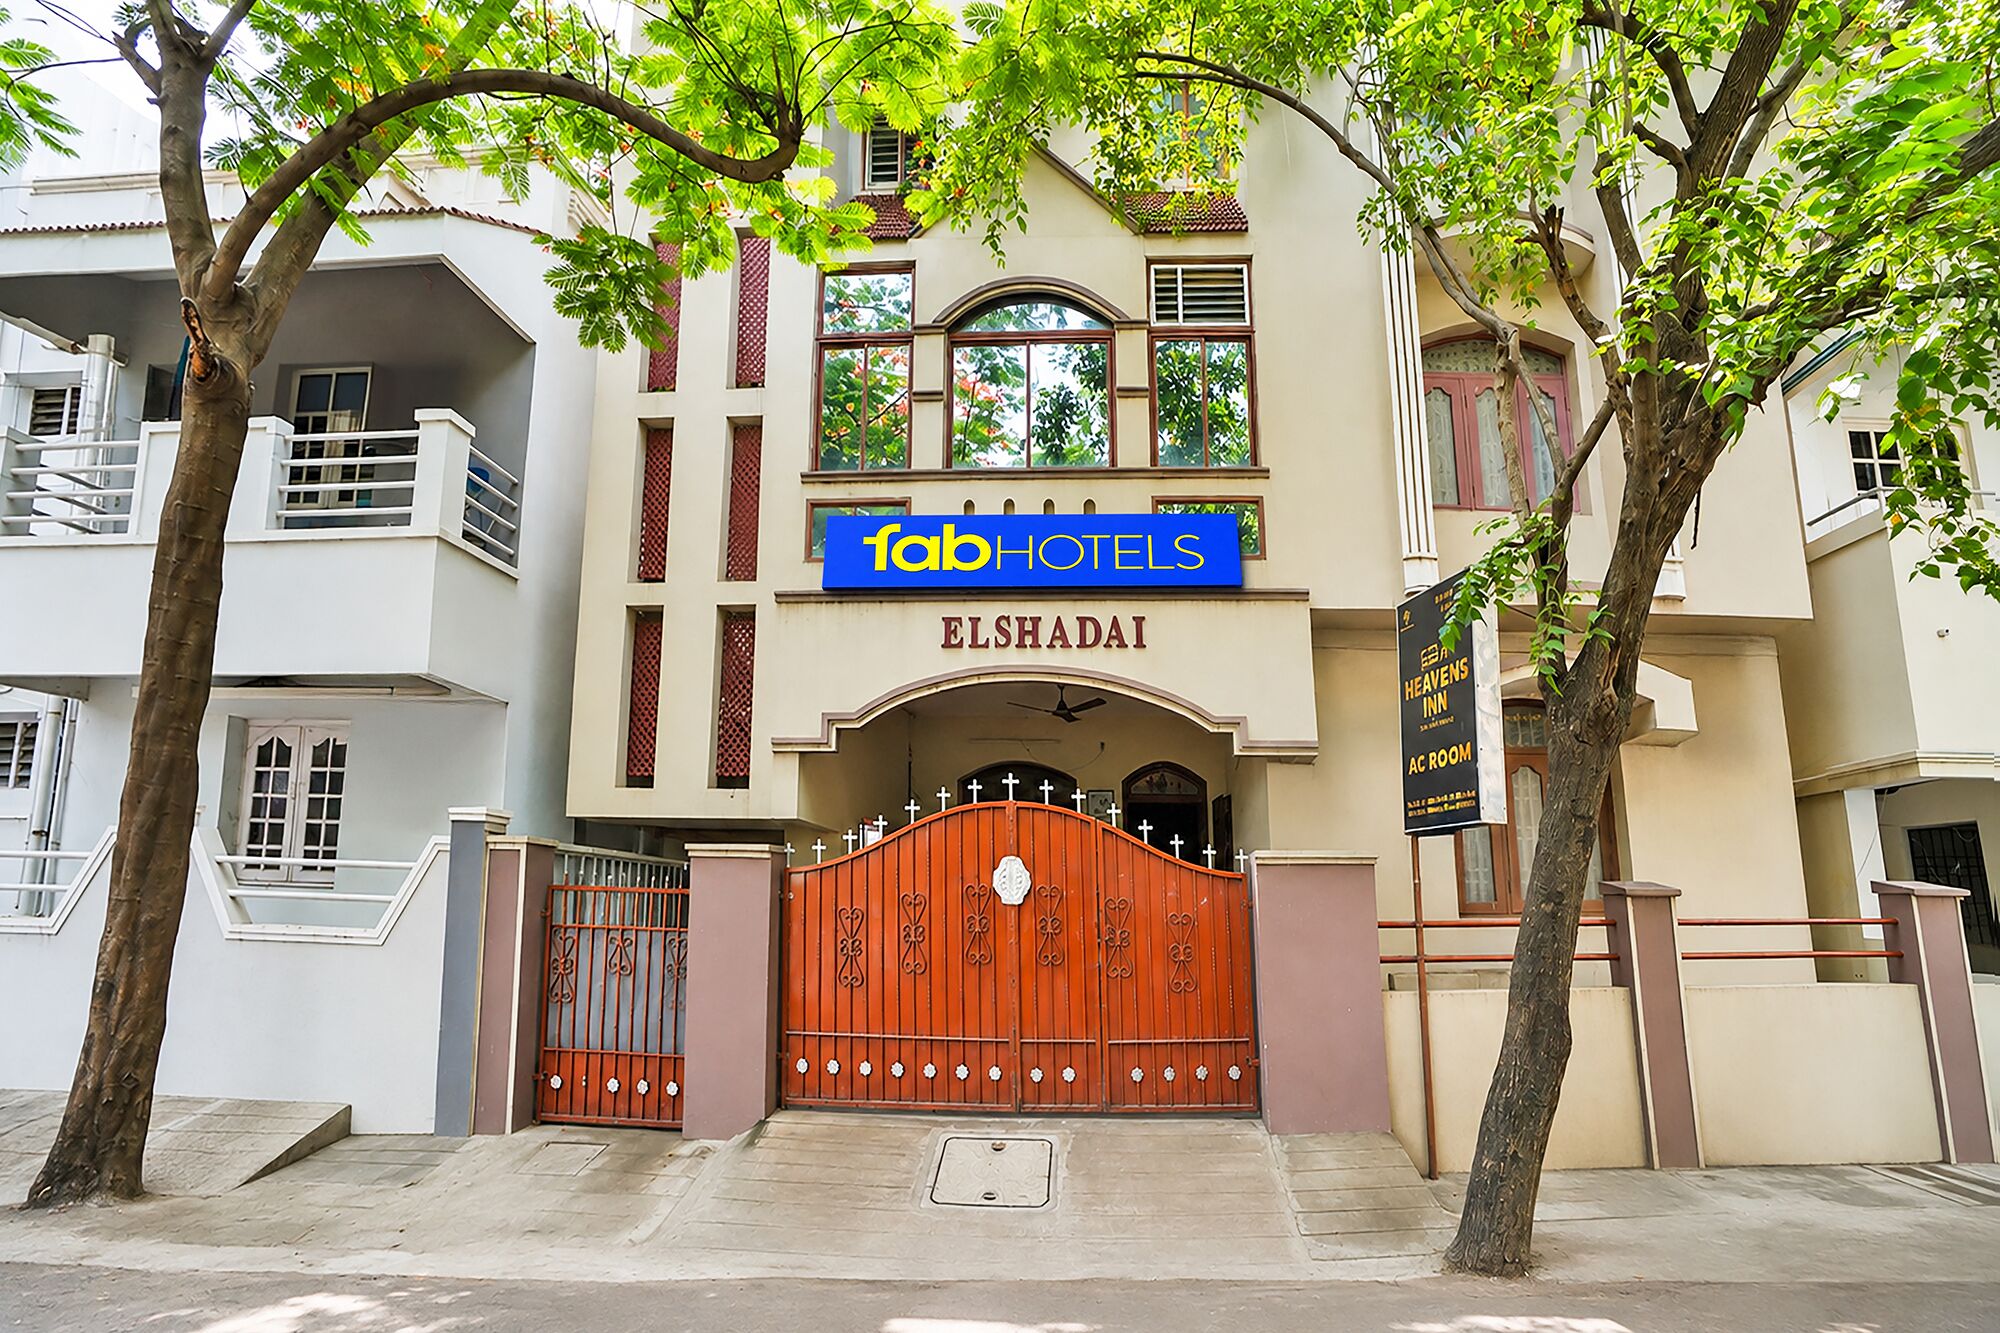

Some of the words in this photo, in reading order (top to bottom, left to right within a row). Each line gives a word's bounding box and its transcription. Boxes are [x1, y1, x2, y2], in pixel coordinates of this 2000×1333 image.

[940, 614, 1147, 649] ELSHADAI
[1404, 656, 1469, 701] HEAVENS
[1422, 689, 1448, 719] INN
[1408, 754, 1426, 776] AC
[1428, 741, 1472, 770] ROOM
